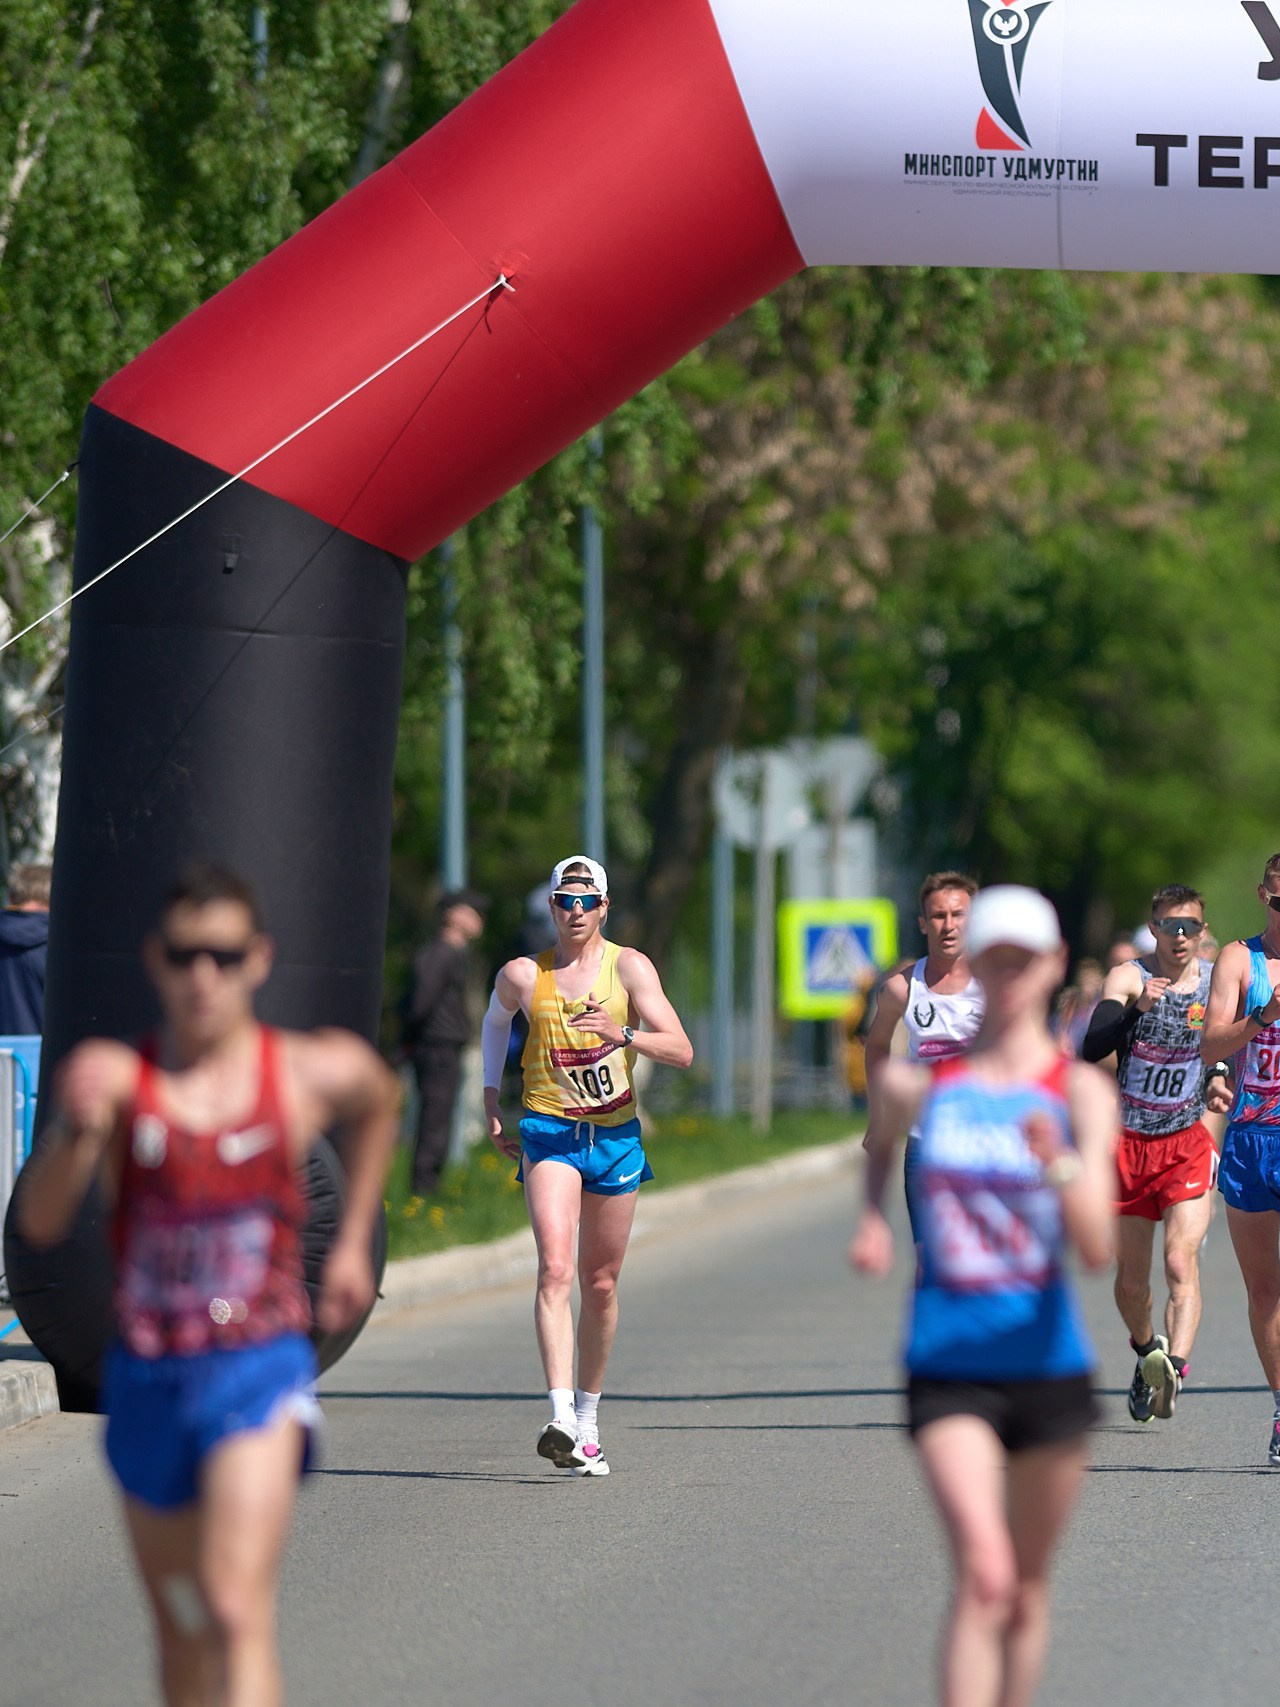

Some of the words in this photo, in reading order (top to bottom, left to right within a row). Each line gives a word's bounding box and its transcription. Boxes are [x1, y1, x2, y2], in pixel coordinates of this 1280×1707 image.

[904, 153, 997, 178] МИНСПОРТ
[1003, 157, 1099, 182] УДМУРТИИ
[568, 1064, 615, 1099] 109
[1142, 1065, 1188, 1098] 108
